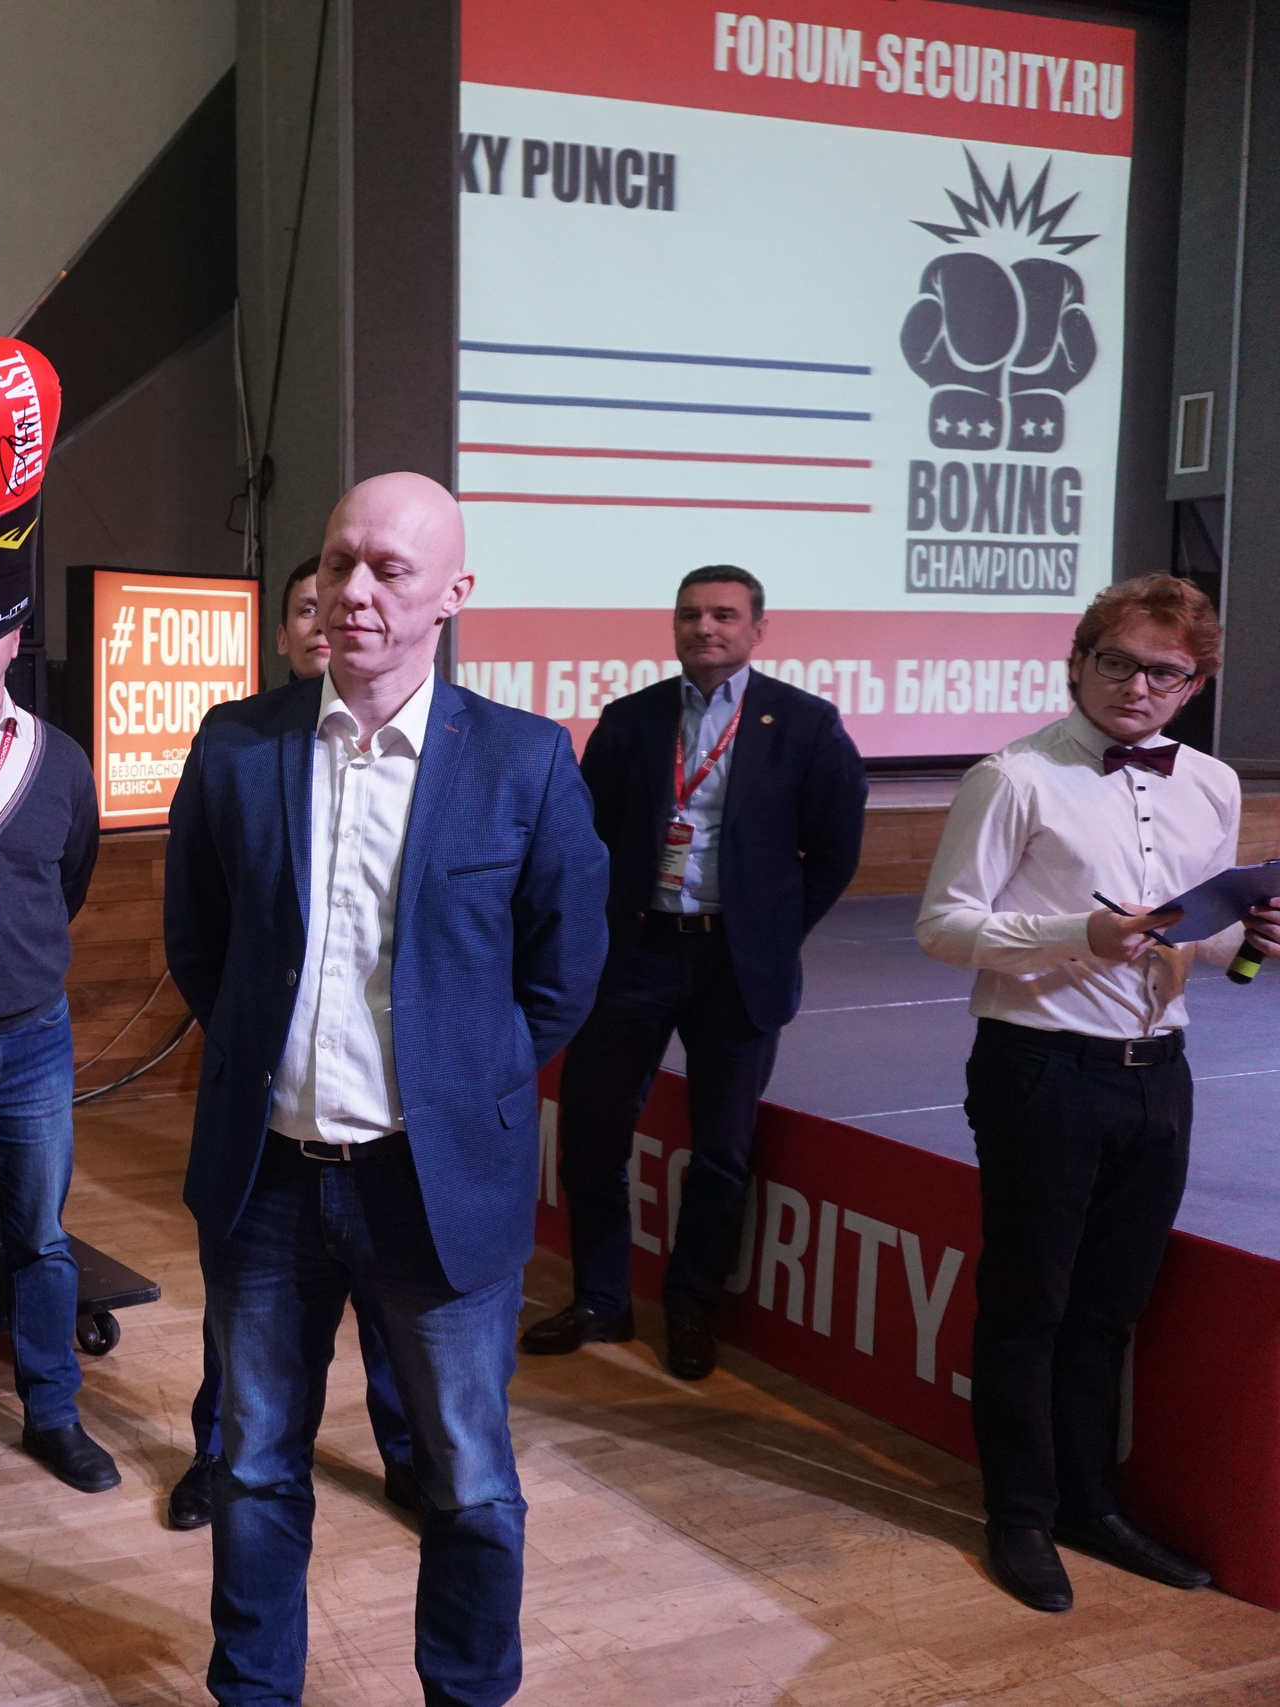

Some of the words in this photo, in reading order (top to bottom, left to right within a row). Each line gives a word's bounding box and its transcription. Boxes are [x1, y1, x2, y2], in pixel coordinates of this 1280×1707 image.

[714, 12, 1124, 119] FORUM-SECURITY.RU
[522, 137, 676, 211] PUNCH
[907, 460, 1083, 536] BOXING
[911, 544, 1074, 591] CHAMPIONS
[143, 607, 245, 666] FORUM
[894, 659, 1069, 714] БИЗНЕСА
[111, 780, 162, 796] БИЗНЕСА
[112, 763, 184, 778] БЕЗОПАСНО
